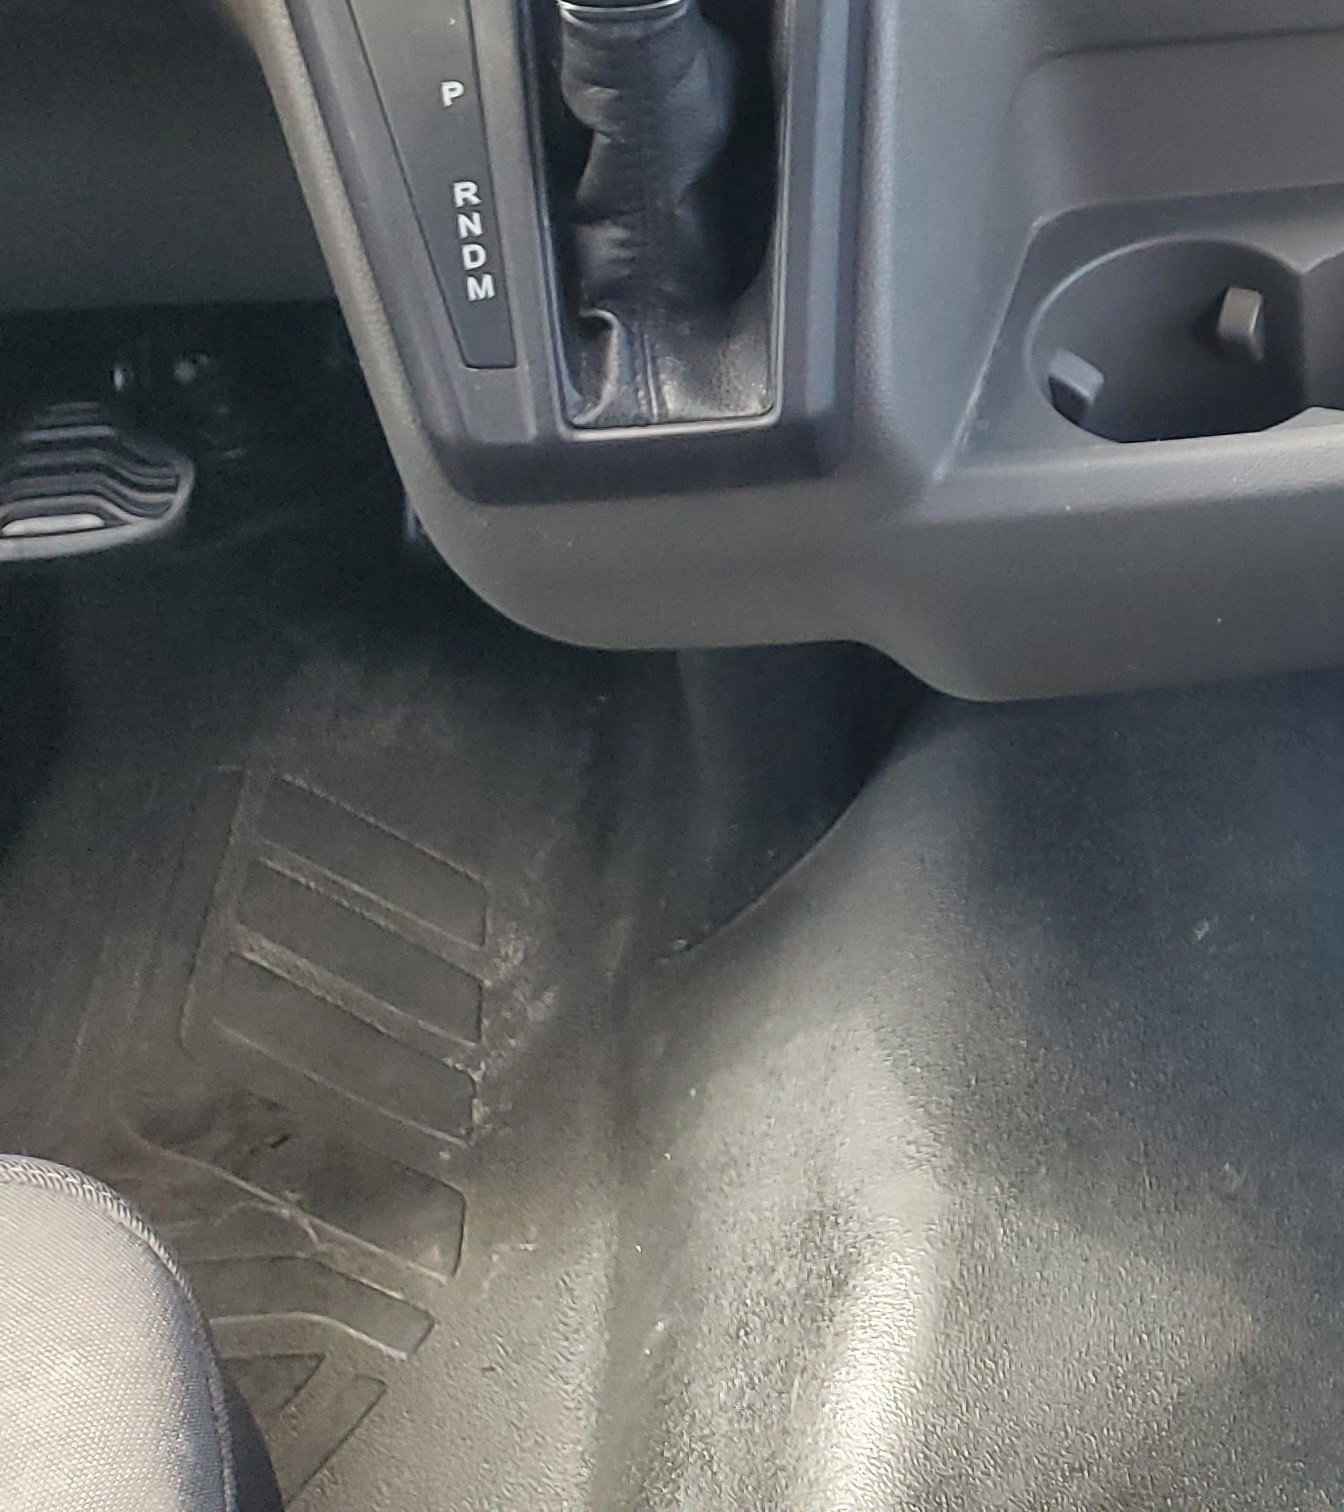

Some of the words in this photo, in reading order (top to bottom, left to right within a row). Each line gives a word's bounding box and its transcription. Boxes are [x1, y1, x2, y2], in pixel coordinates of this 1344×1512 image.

[440, 80, 465, 108] P
[453, 180, 482, 207] R
[456, 212, 482, 238] N
[461, 243, 487, 271] D
[465, 273, 495, 302] M
